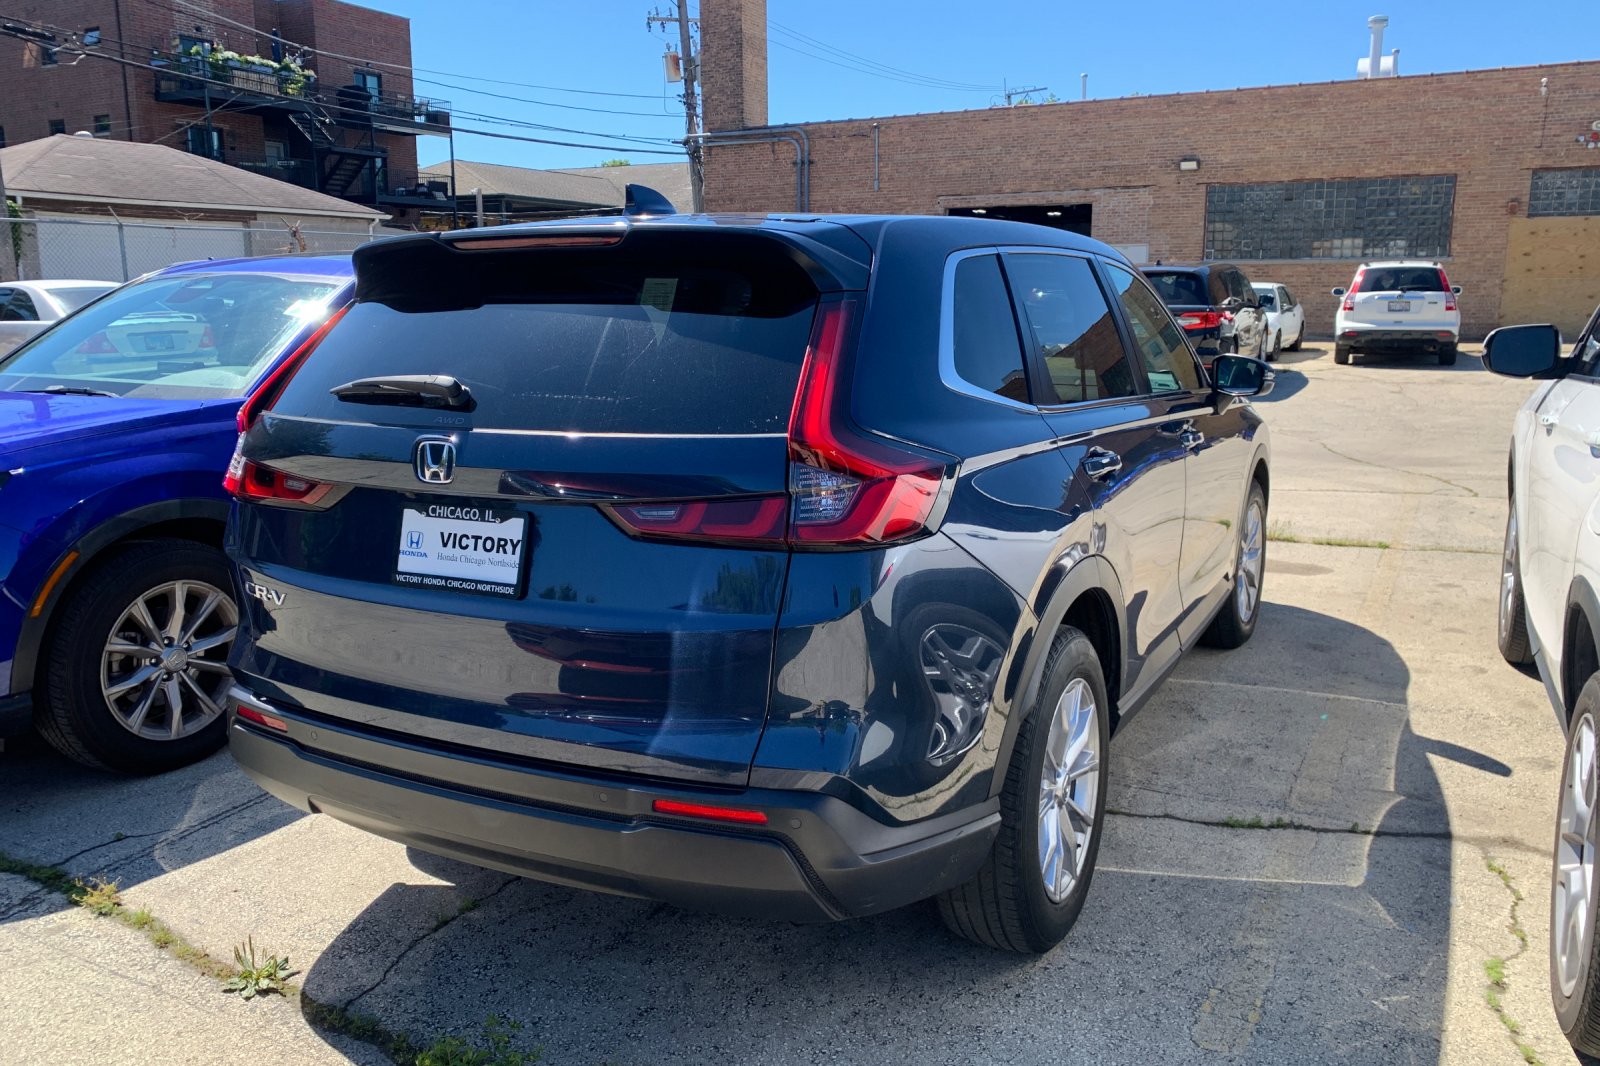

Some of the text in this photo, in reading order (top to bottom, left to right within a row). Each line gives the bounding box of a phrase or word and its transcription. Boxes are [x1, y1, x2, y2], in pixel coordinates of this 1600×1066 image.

[433, 416, 465, 425] AWD
[428, 505, 495, 521] CHICAGO, IL
[440, 531, 522, 556] VICTORY
[399, 549, 429, 559] HONDA
[437, 552, 520, 569] Honda Chicago Northside
[396, 573, 515, 595] VICTORY HONDA CHICAGO NORTHSIDE
[245, 581, 287, 606] CR-V
